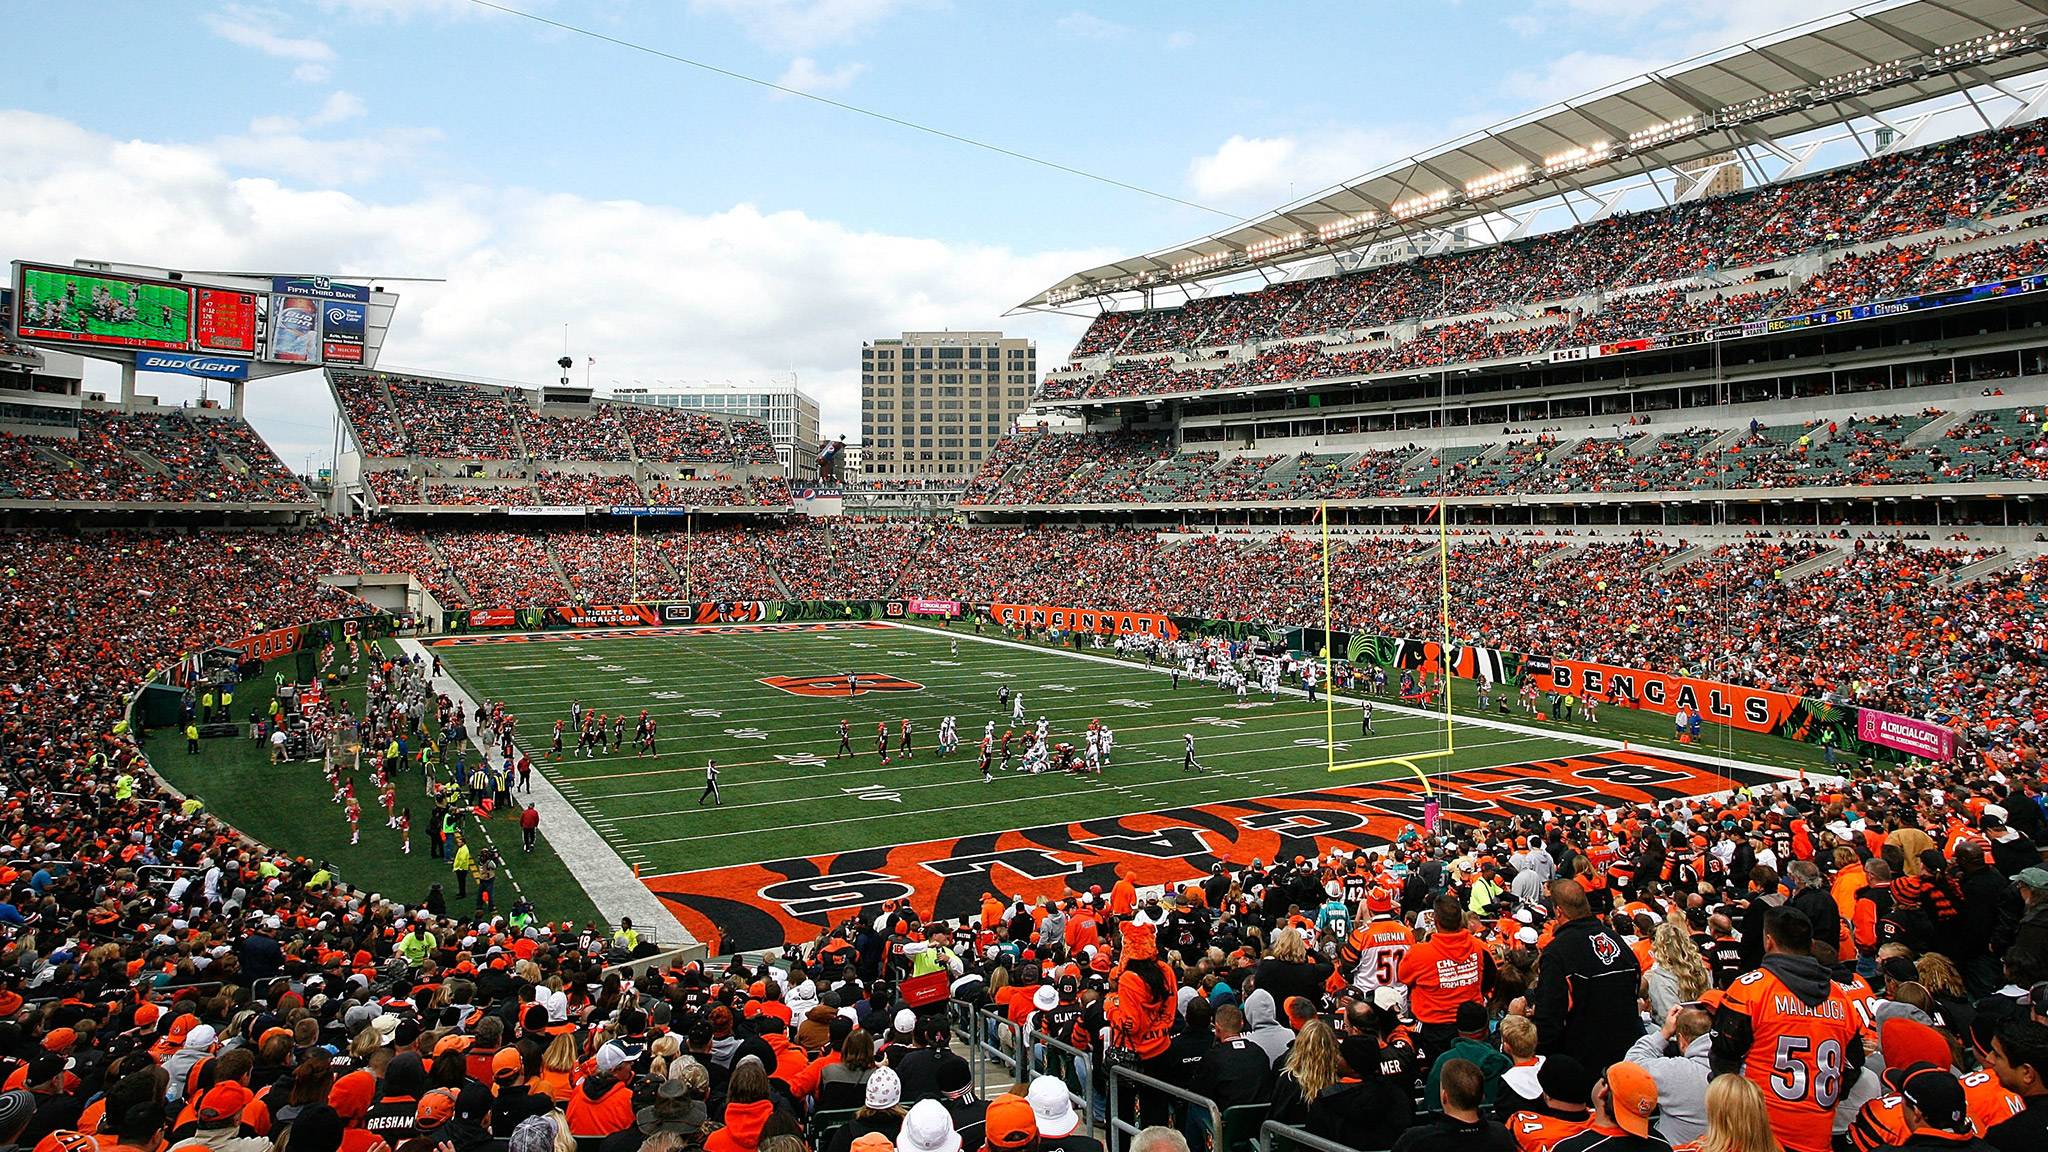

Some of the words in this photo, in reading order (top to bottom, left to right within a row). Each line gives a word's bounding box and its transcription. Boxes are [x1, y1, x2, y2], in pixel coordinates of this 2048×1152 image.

[311, 288, 334, 297] THIRD
[2021, 280, 2035, 292] 51
[1821, 314, 1827, 323] 8
[1835, 309, 1853, 321] STL
[1874, 302, 1909, 315] Givens
[145, 357, 187, 368] BUD
[194, 361, 241, 372] LIGHT
[571, 614, 640, 623] BENGALS.COM
[671, 609, 687, 617] 25
[1002, 608, 1168, 635] CINCINNATI
[242, 631, 294, 661] NGALS
[1552, 665, 1769, 725] BENGALS
[1880, 721, 1888, 731] A
[1887, 724, 1917, 738] CRUCIAL
[1918, 730, 1939, 746] CATCH
[841, 784, 902, 803] 10
[757, 763, 1696, 916] BENGALS
[1777, 840, 1789, 858] 56
[1347, 887, 1364, 901] 42
[1229, 903, 1236, 916] 9
[579, 935, 591, 949] 18
[1373, 932, 1405, 942] THURMAN
[1380, 1059, 1402, 1075] MER
[1769, 1035, 1843, 1110] 58
[367, 1115, 414, 1130] GRESHAM
[1517, 1112, 1543, 1133] 24
